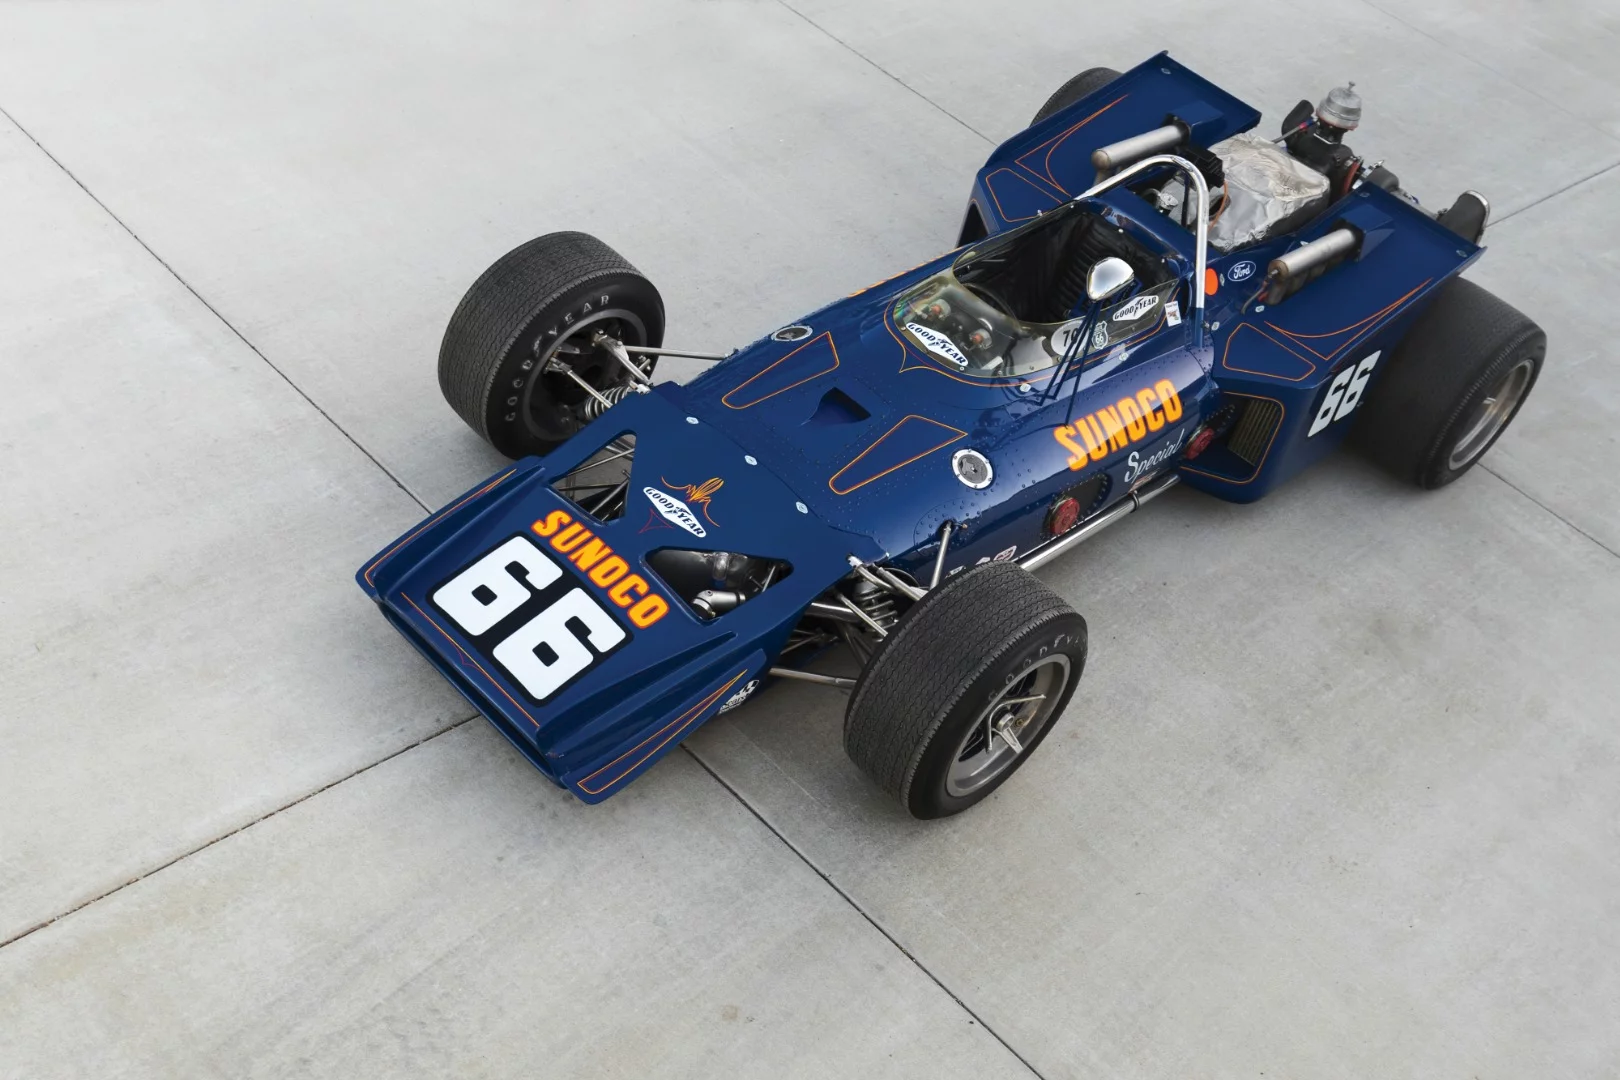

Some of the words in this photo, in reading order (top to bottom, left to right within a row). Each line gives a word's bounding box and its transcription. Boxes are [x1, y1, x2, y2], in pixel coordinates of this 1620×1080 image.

[1232, 262, 1251, 280] Ford
[1053, 377, 1184, 472] SUNOCO
[1307, 350, 1382, 438] 66
[1123, 427, 1184, 485] Special
[530, 509, 671, 630] SUNOCO
[432, 535, 627, 701] 66
